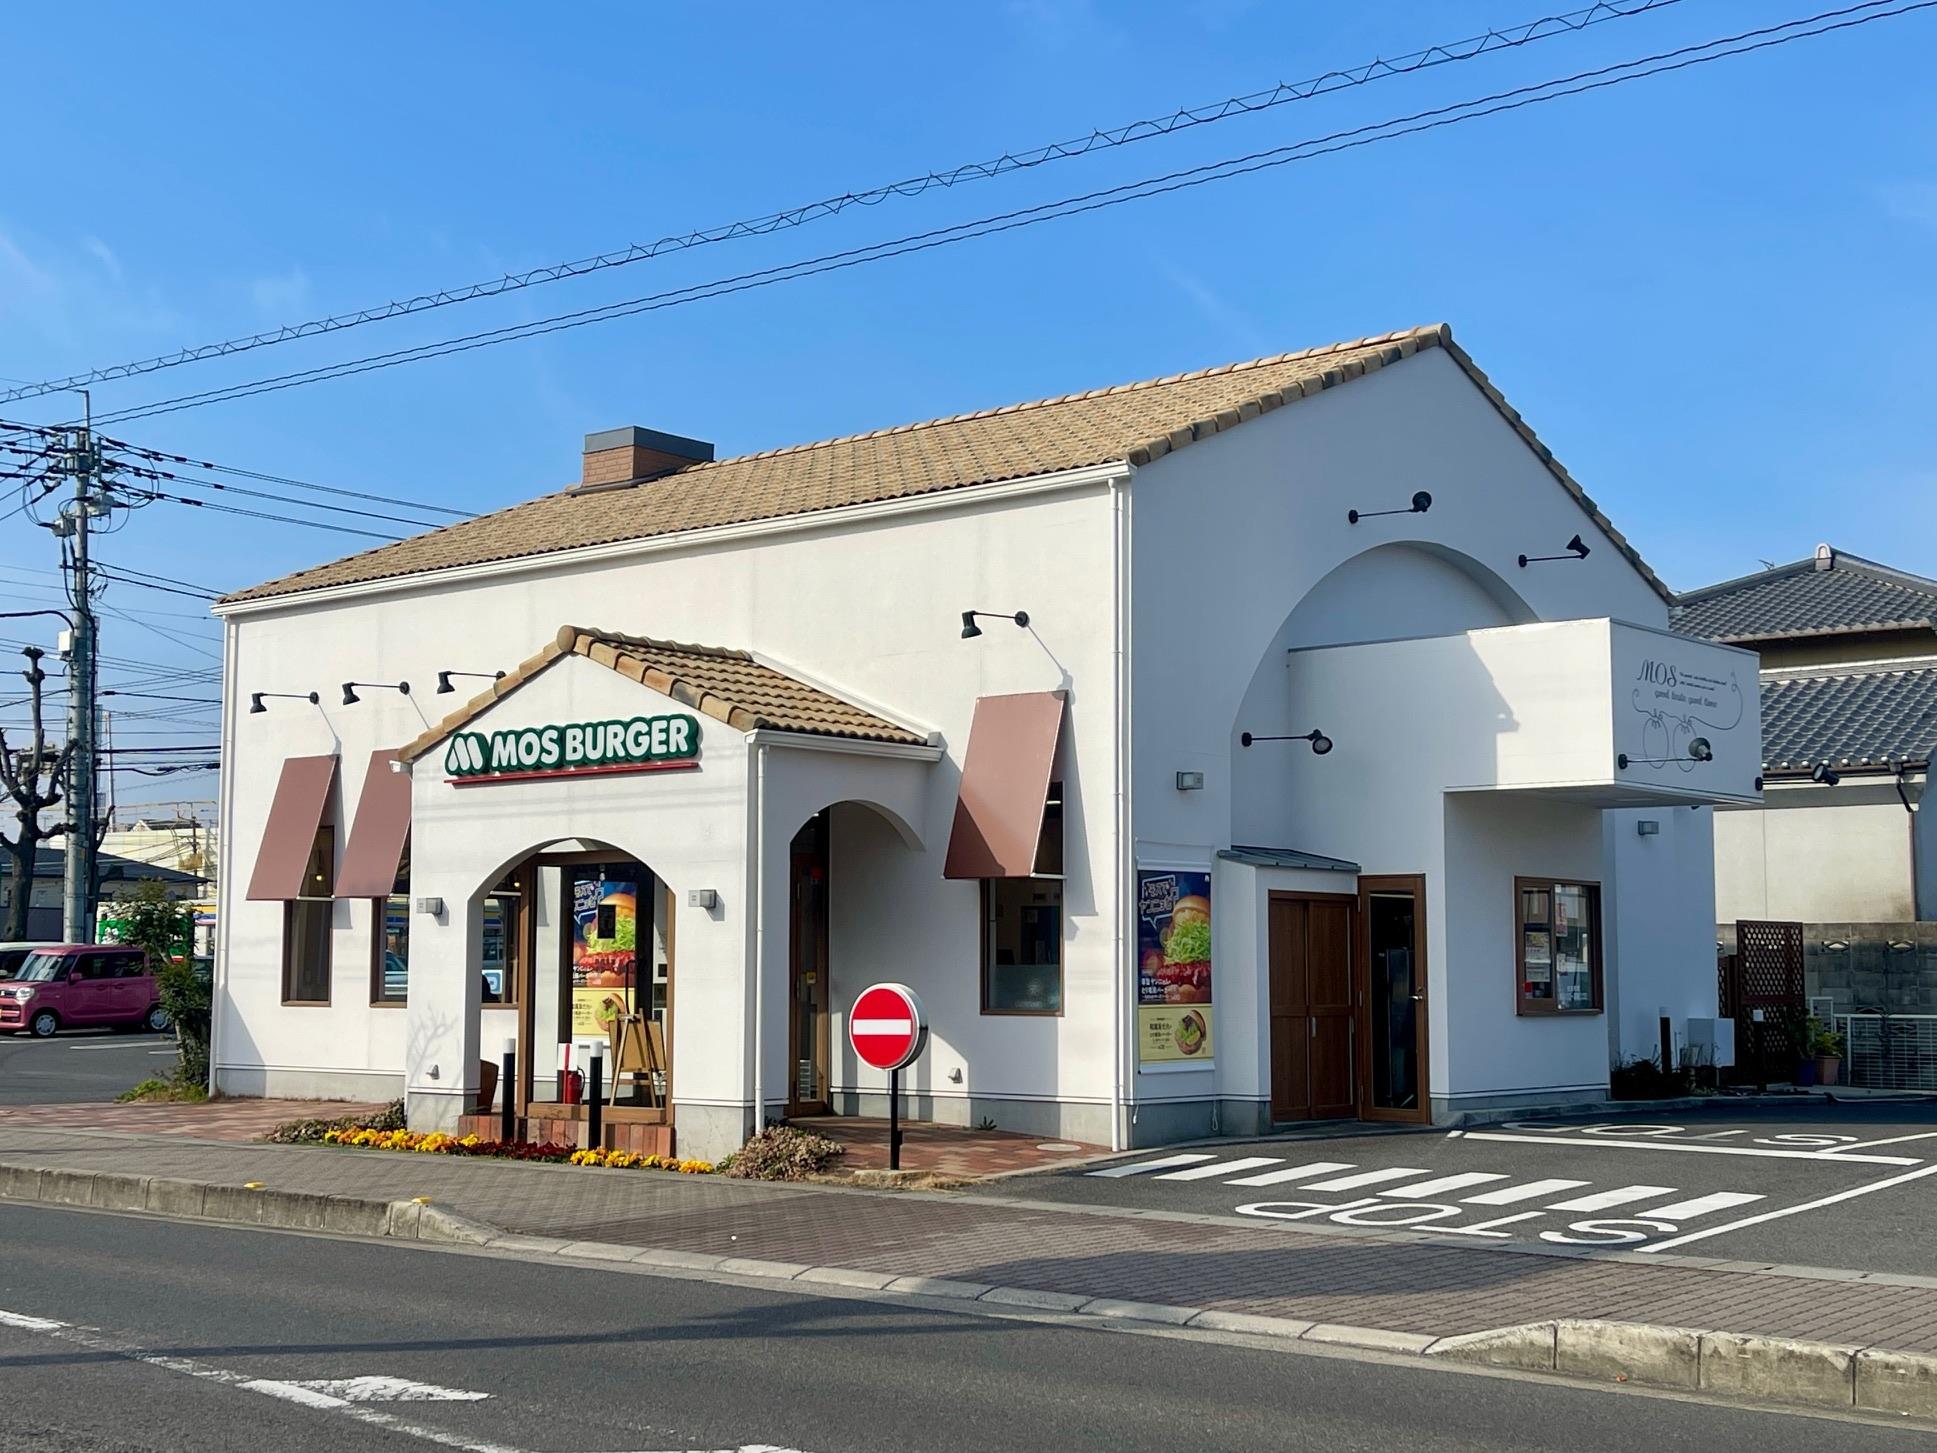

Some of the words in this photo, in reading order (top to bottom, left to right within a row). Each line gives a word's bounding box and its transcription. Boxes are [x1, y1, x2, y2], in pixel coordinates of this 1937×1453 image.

[1637, 659, 1678, 688] MOS
[491, 729, 560, 767] MOS
[564, 718, 690, 761] BURGER
[1235, 1197, 1679, 1245] STOP
